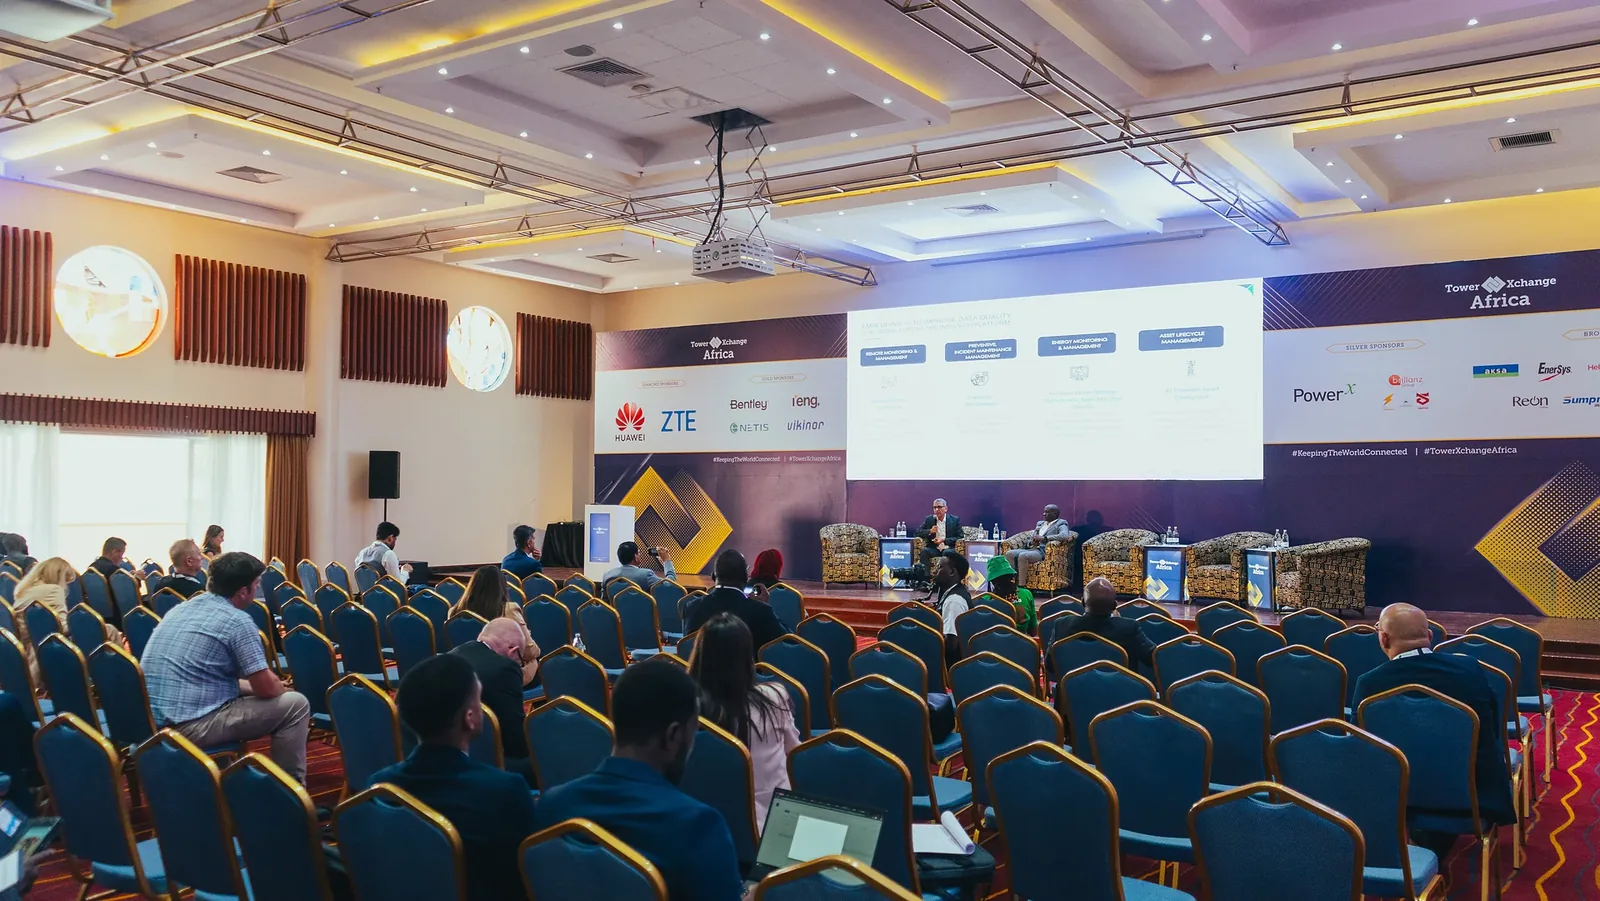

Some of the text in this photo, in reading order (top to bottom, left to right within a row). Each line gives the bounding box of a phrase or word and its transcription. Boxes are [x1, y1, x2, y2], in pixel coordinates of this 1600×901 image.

[1445, 277, 1556, 293] Tower Xchange
[1470, 294, 1530, 310] Africa
[703, 349, 734, 360] Africa
[1538, 362, 1571, 376] EnerSys
[730, 399, 768, 410] Bentley
[661, 410, 696, 432] ZTE
[787, 420, 824, 430] vikinor
[740, 424, 769, 432] NETIS
[1292, 447, 1517, 458] #KeepingTheWorldConnected #TowerXchangeAfrica
